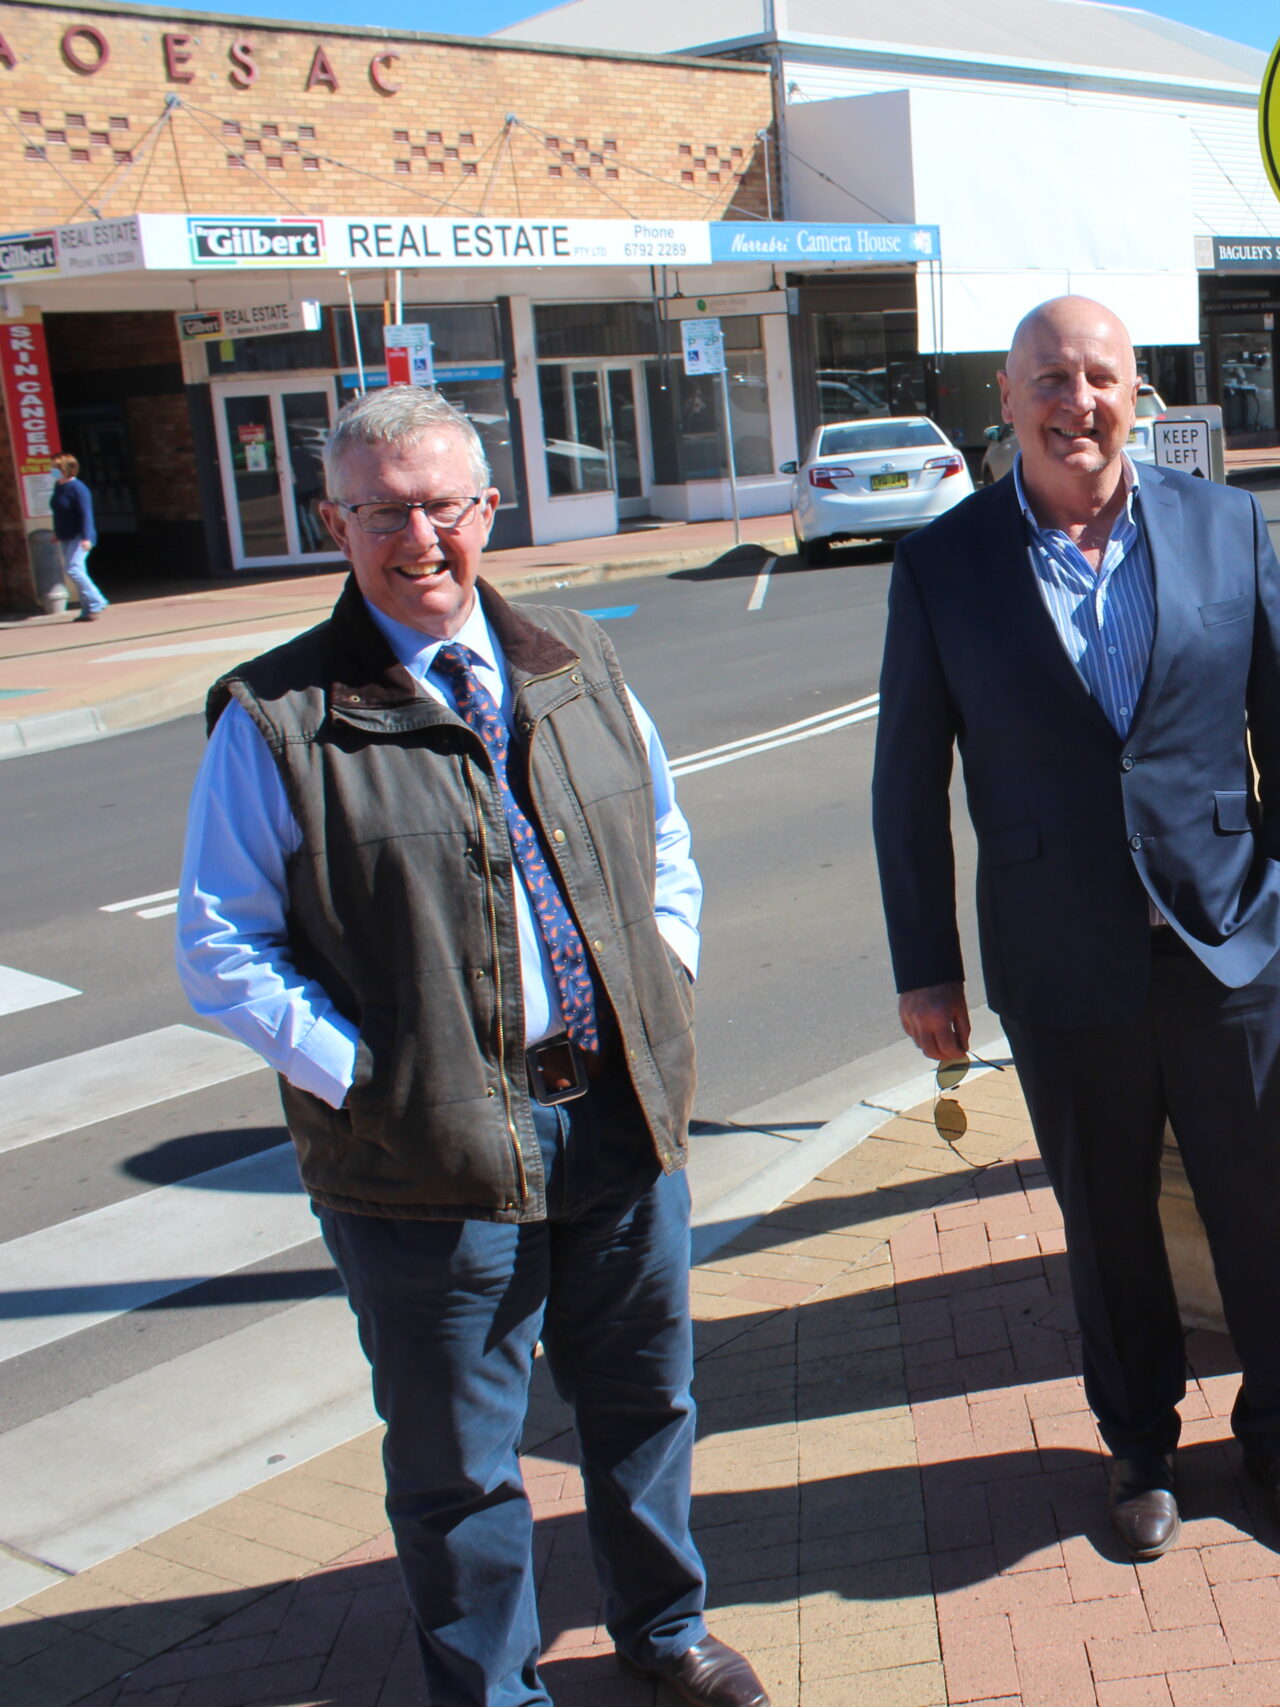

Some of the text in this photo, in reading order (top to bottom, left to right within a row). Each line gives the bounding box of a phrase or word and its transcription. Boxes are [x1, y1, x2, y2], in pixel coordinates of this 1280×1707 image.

[61, 222, 137, 248] REAL ESTATE
[206, 227, 317, 255] Gilbert
[348, 224, 441, 257] REAL
[452, 224, 570, 257] ESTATE
[634, 225, 675, 239] Phone
[731, 230, 901, 253] Narrabri Camera House
[624, 243, 687, 257] 6792 2289
[1218, 245, 1272, 260] BAGULEY'S
[224, 304, 289, 325] REAL ESTATE
[9, 326, 38, 376] SKIN
[17, 381, 51, 456] CANCER
[1163, 429, 1198, 444] KEEP
[1165, 449, 1198, 464] LEFT
